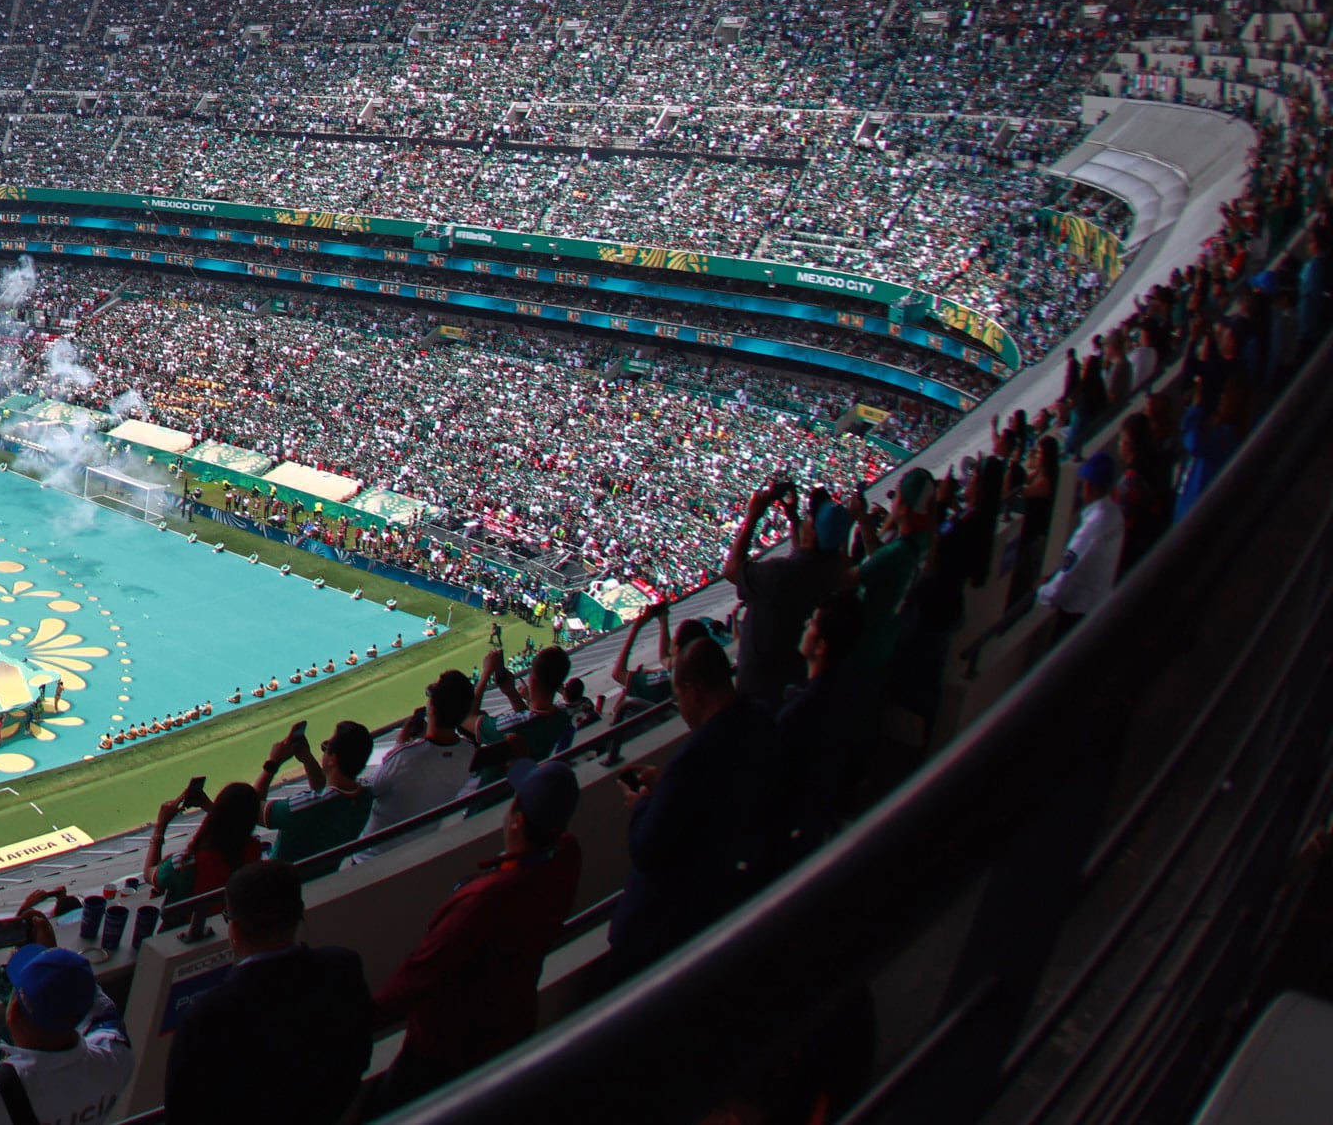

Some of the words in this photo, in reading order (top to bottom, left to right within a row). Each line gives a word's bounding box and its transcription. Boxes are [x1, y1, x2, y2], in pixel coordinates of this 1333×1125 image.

[151, 199, 190, 210] MEXICO
[192, 202, 215, 212] CITY
[60, 217, 69, 225] GO
[183, 255, 194, 266] GO
[796, 271, 846, 289] MEXICO
[847, 279, 875, 295] CITY
[7, 841, 59, 861] AFRICA
